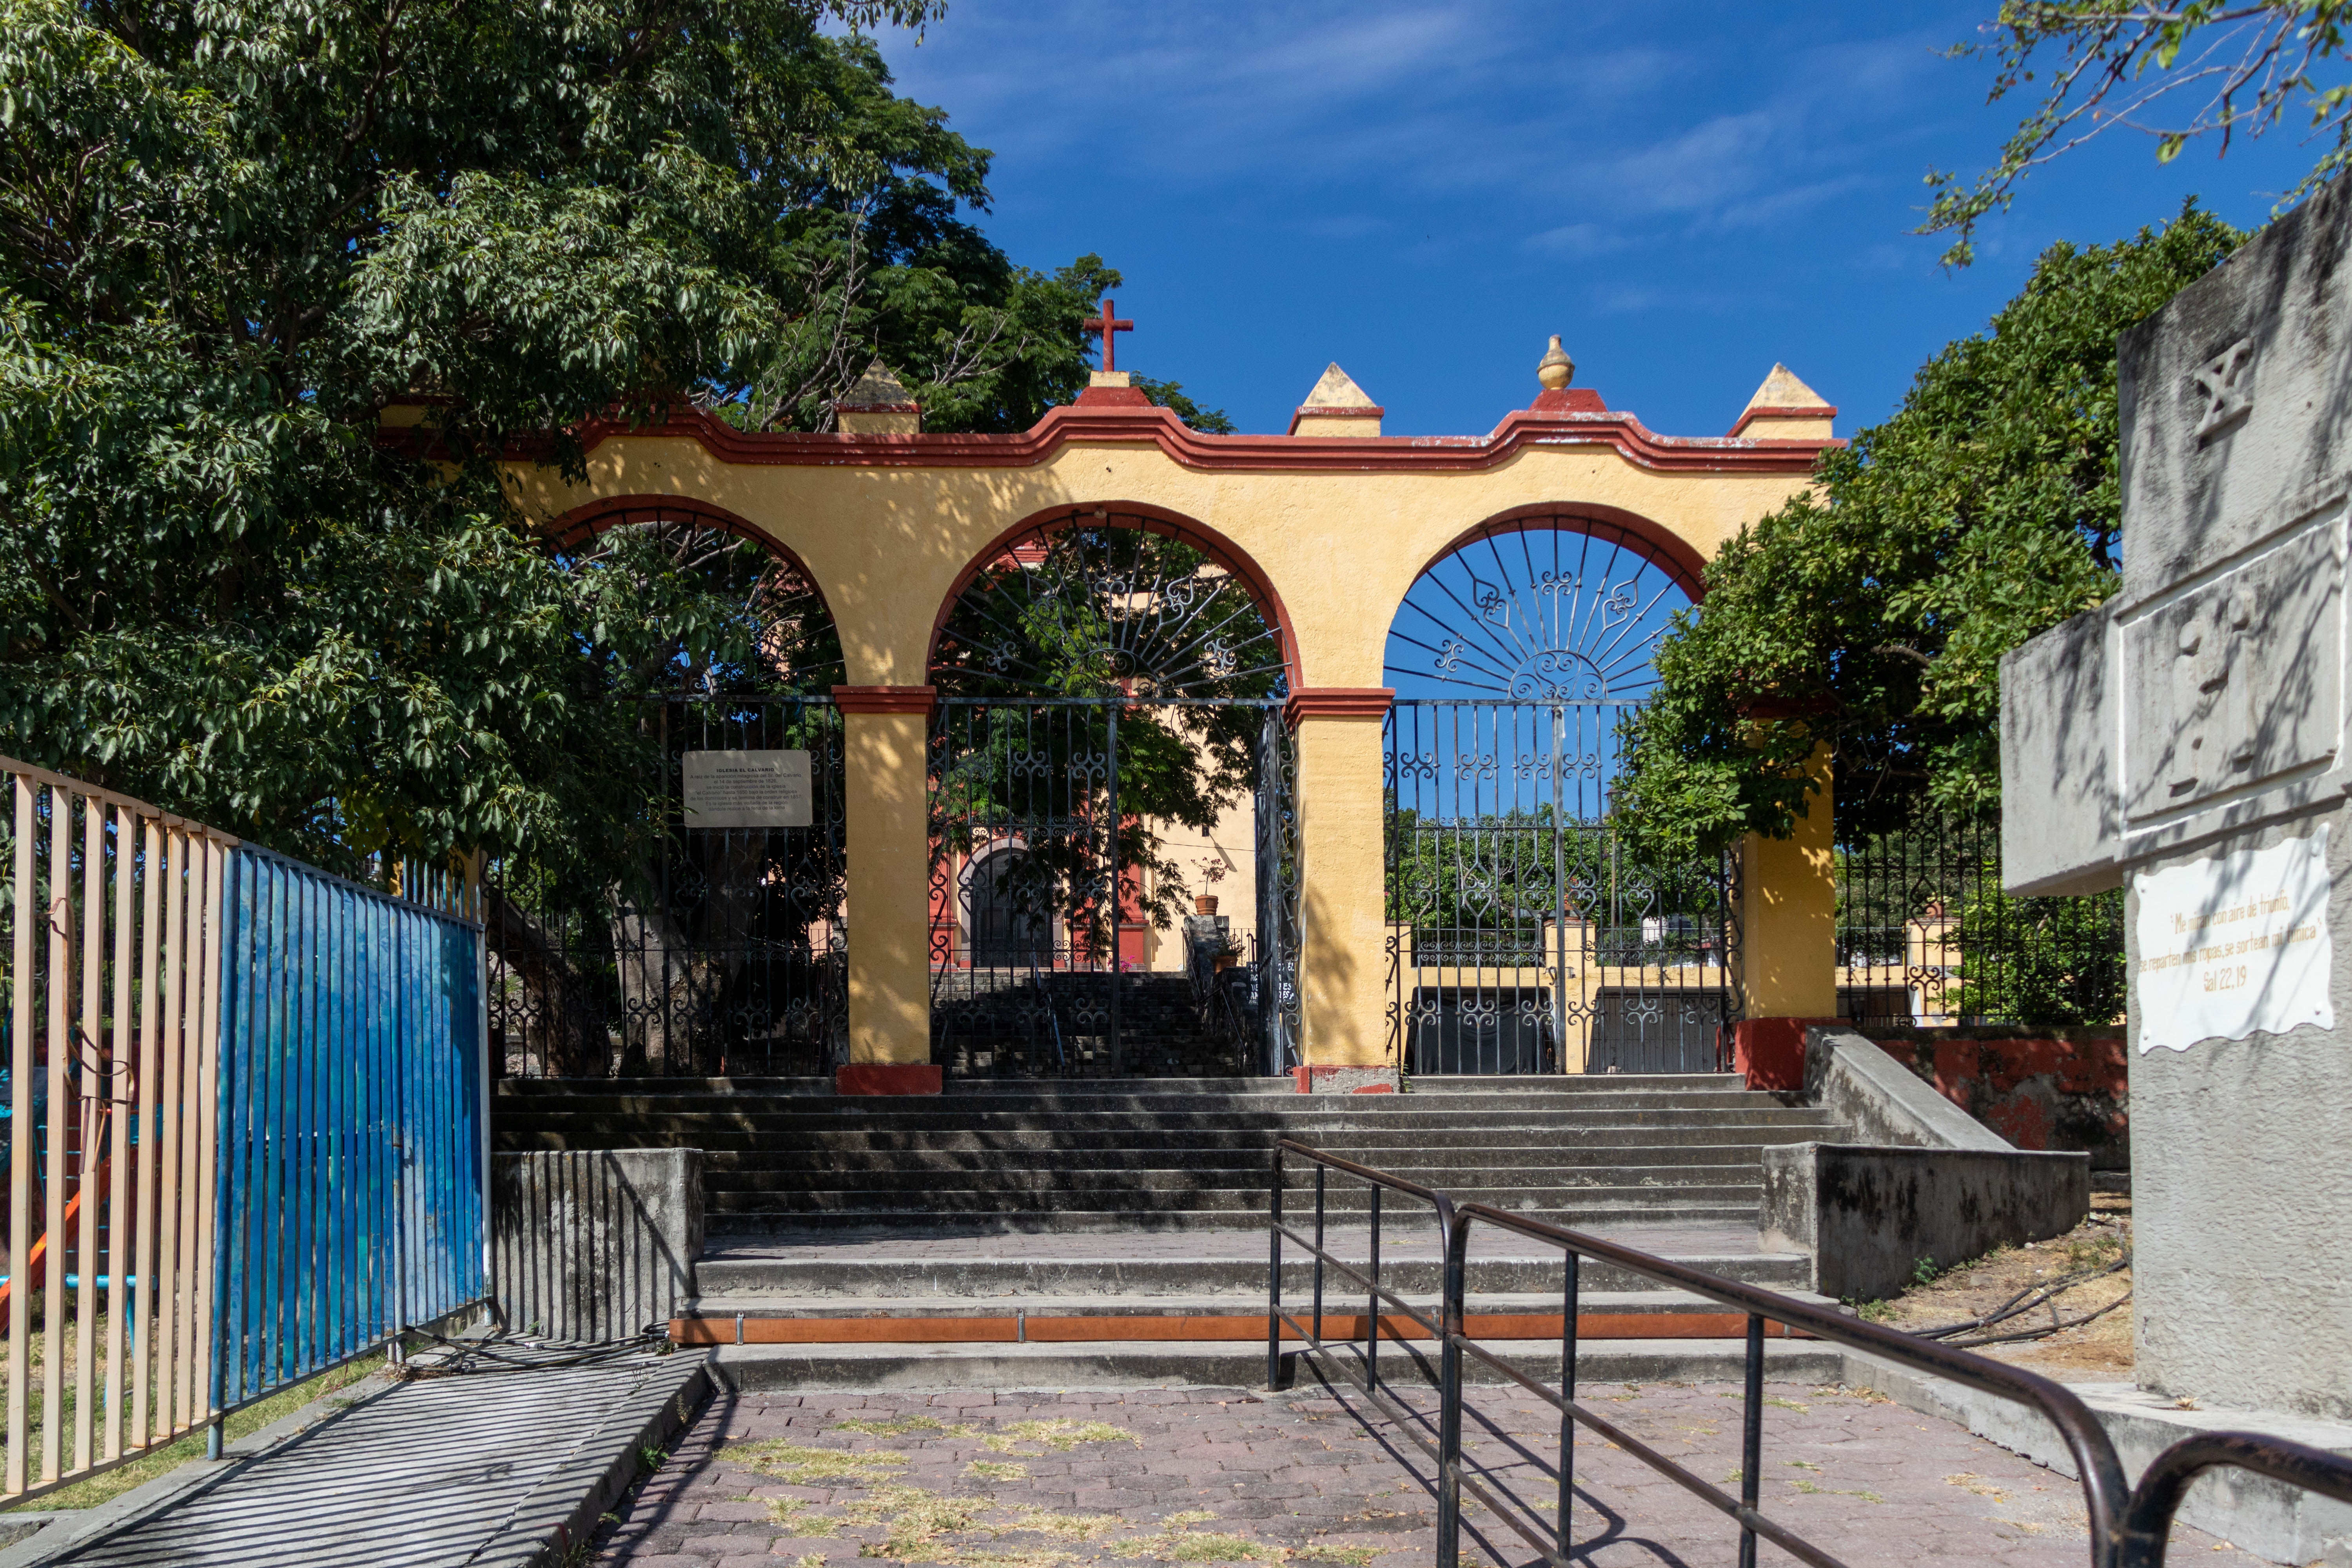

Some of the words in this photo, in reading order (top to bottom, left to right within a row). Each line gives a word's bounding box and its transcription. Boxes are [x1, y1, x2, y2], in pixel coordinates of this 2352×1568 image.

[2188, 911, 2210, 931] miran
[2212, 909, 2227, 926] con
[2228, 902, 2245, 923] aire
[2247, 895, 2257, 918] de
[2139, 959, 2147, 973] se
[2148, 947, 2181, 974] reparten
[2183, 945, 2197, 965] mis
[2236, 930, 2269, 954] sortean
[2271, 926, 2283, 947] mi
[2203, 970, 2217, 992] Sal
